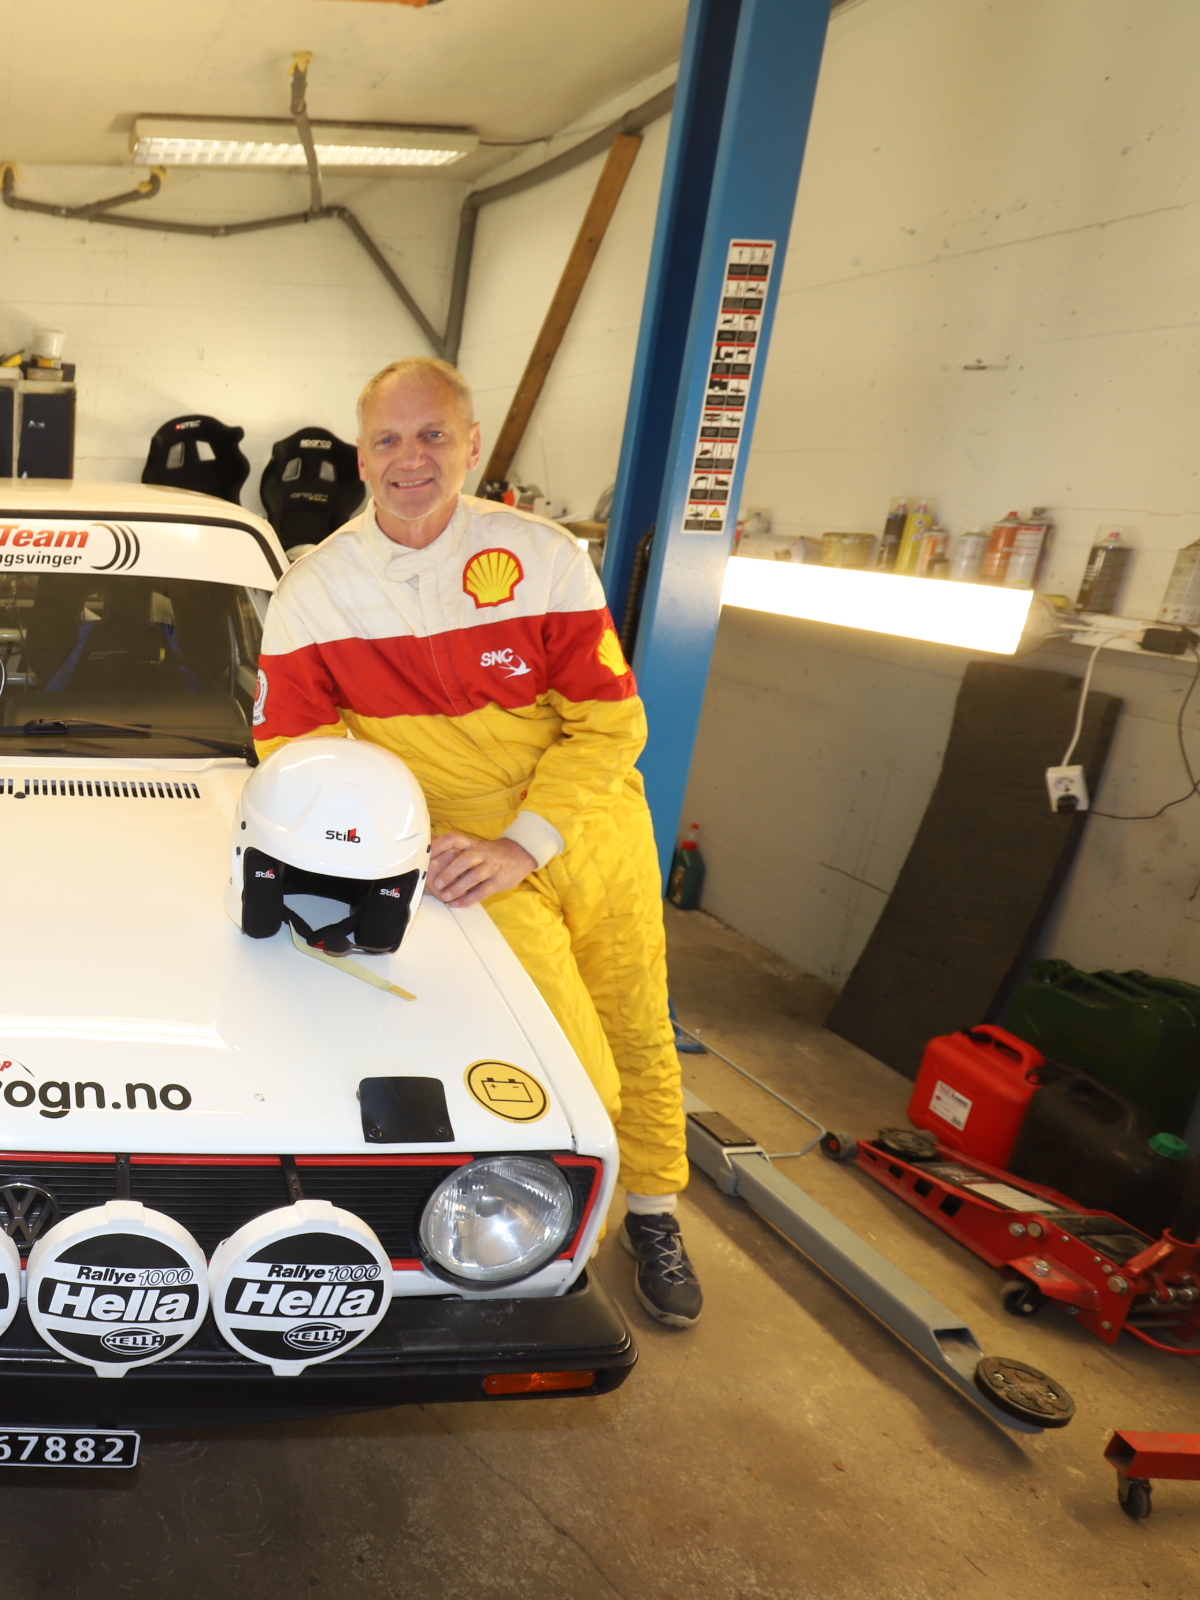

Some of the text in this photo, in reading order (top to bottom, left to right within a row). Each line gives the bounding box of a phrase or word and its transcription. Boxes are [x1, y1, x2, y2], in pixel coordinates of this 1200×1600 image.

[480, 647, 514, 667] SNC
[325, 828, 361, 844] Stilo
[255, 869, 276, 879] Stilo
[379, 888, 401, 898] Stilo
[76, 1266, 194, 1286] Rallye 1000
[267, 1264, 382, 1282] Rallye 1000
[48, 1282, 190, 1322] Hella
[235, 1281, 375, 1317] Hella
[106, 1333, 165, 1346] HELLA
[289, 1329, 346, 1342] HELLA
